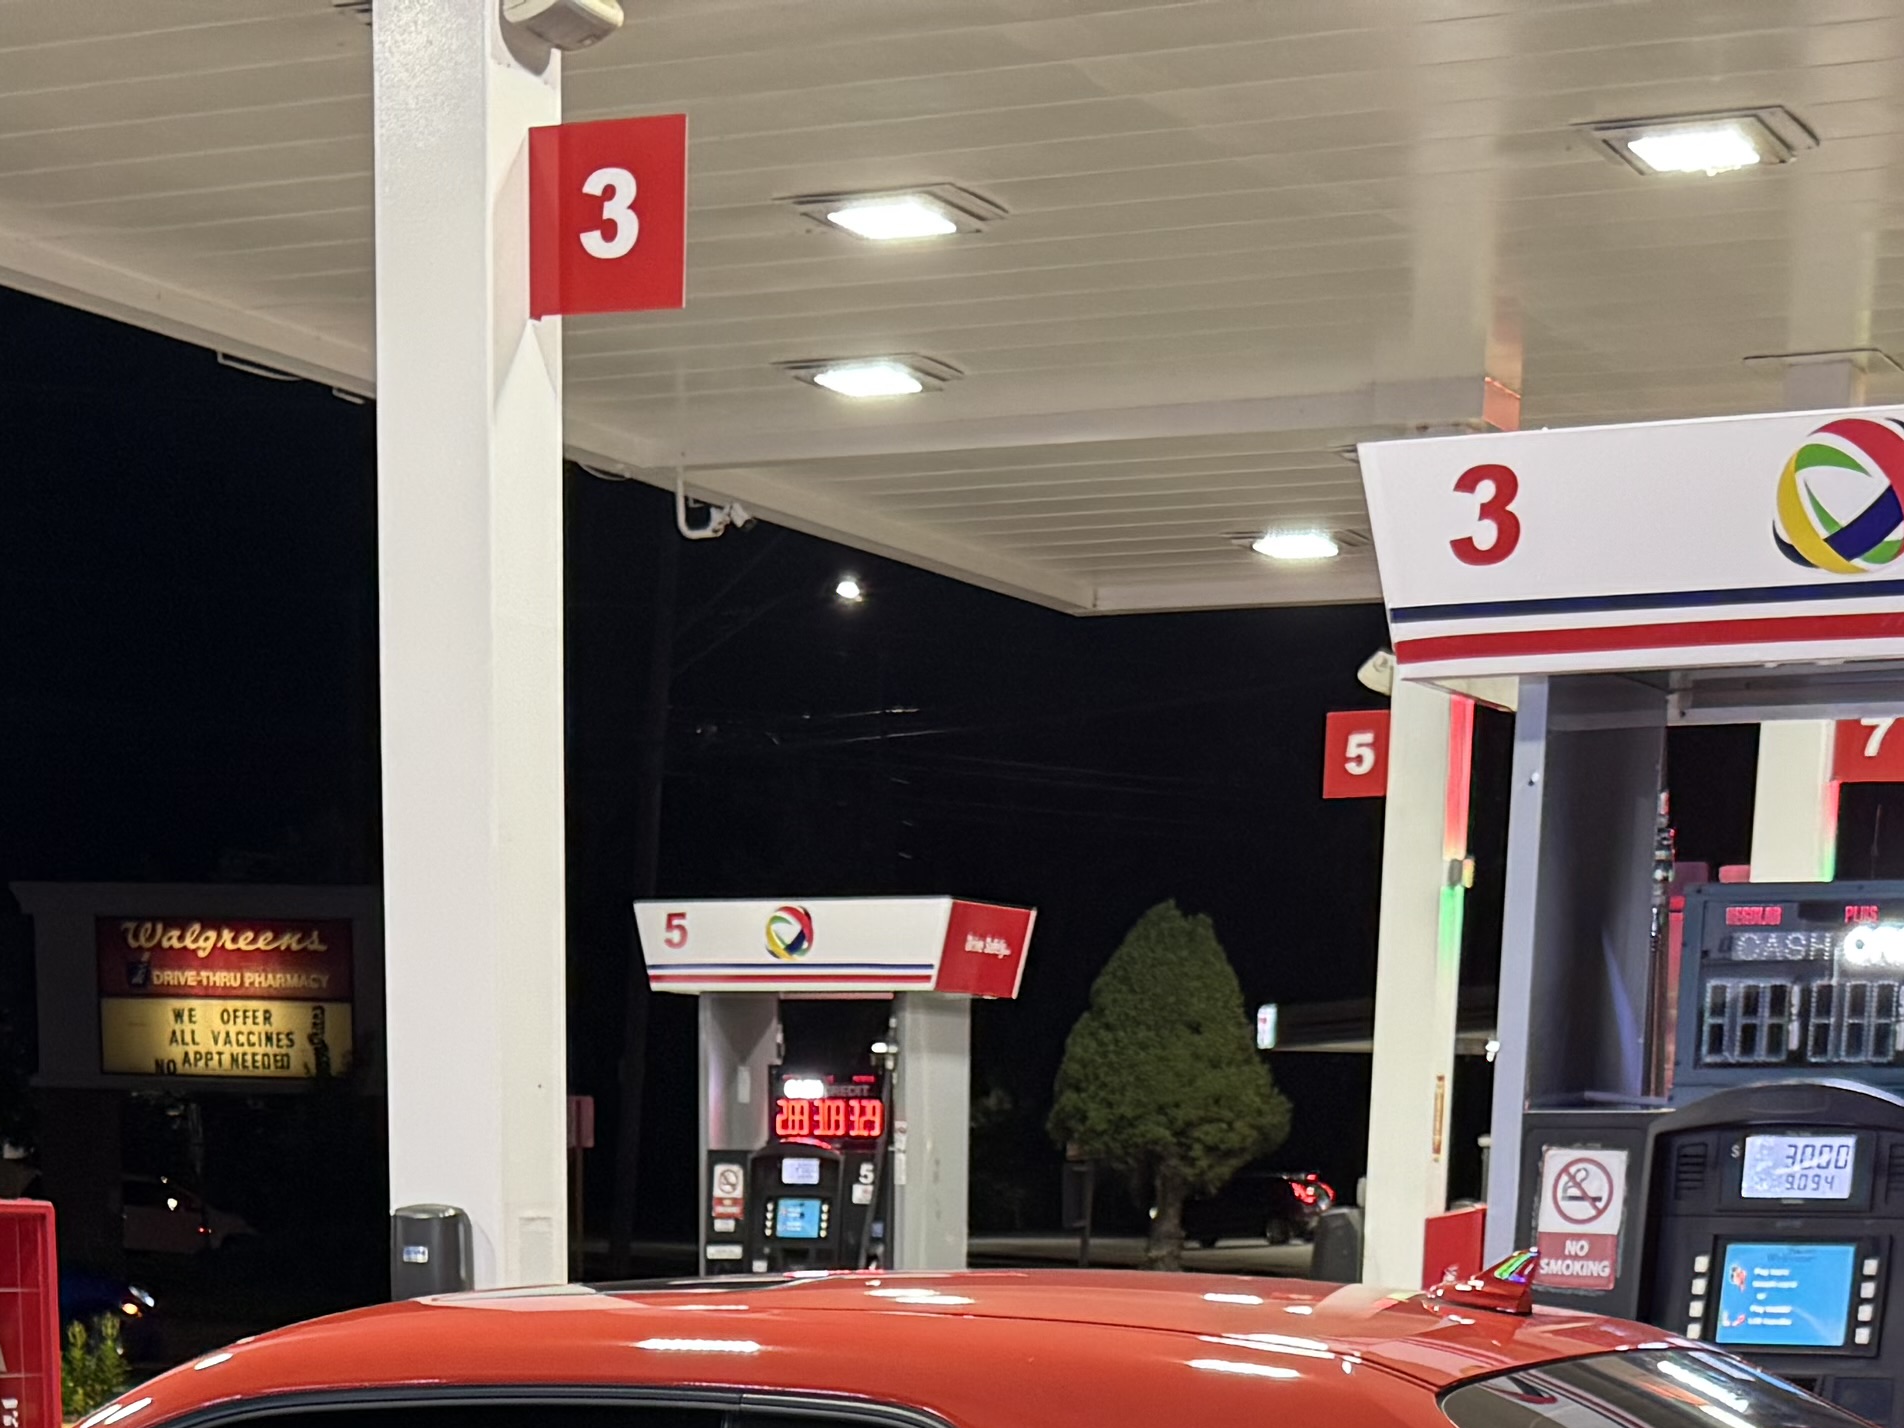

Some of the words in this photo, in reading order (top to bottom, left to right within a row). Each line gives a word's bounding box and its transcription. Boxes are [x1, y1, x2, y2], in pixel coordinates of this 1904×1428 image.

[579, 168, 639, 258] 3
[1449, 463, 1521, 566] 3
[1858, 718, 1896, 756] 7
[1343, 731, 1376, 776] 5
[1845, 905, 1879, 923] PLUS
[121, 921, 328, 958] Walgreens
[664, 912, 689, 949] 5
[1736, 932, 1831, 961] CASH
[153, 971, 241, 988] DRIVE-THRU
[244, 971, 329, 989] PHARMACY
[172, 1008, 197, 1025] WE
[220, 1008, 273, 1026] OFFER
[169, 1029, 200, 1047] ALL
[211, 1030, 296, 1049] VACCINES
[155, 1058, 177, 1075] NO
[182, 1051, 225, 1070] APPT
[230, 1052, 291, 1071] NEEDED
[858, 1163, 875, 1184] 5
[1564, 1239, 1589, 1257] NO
[1540, 1258, 1611, 1277] SMOKING
